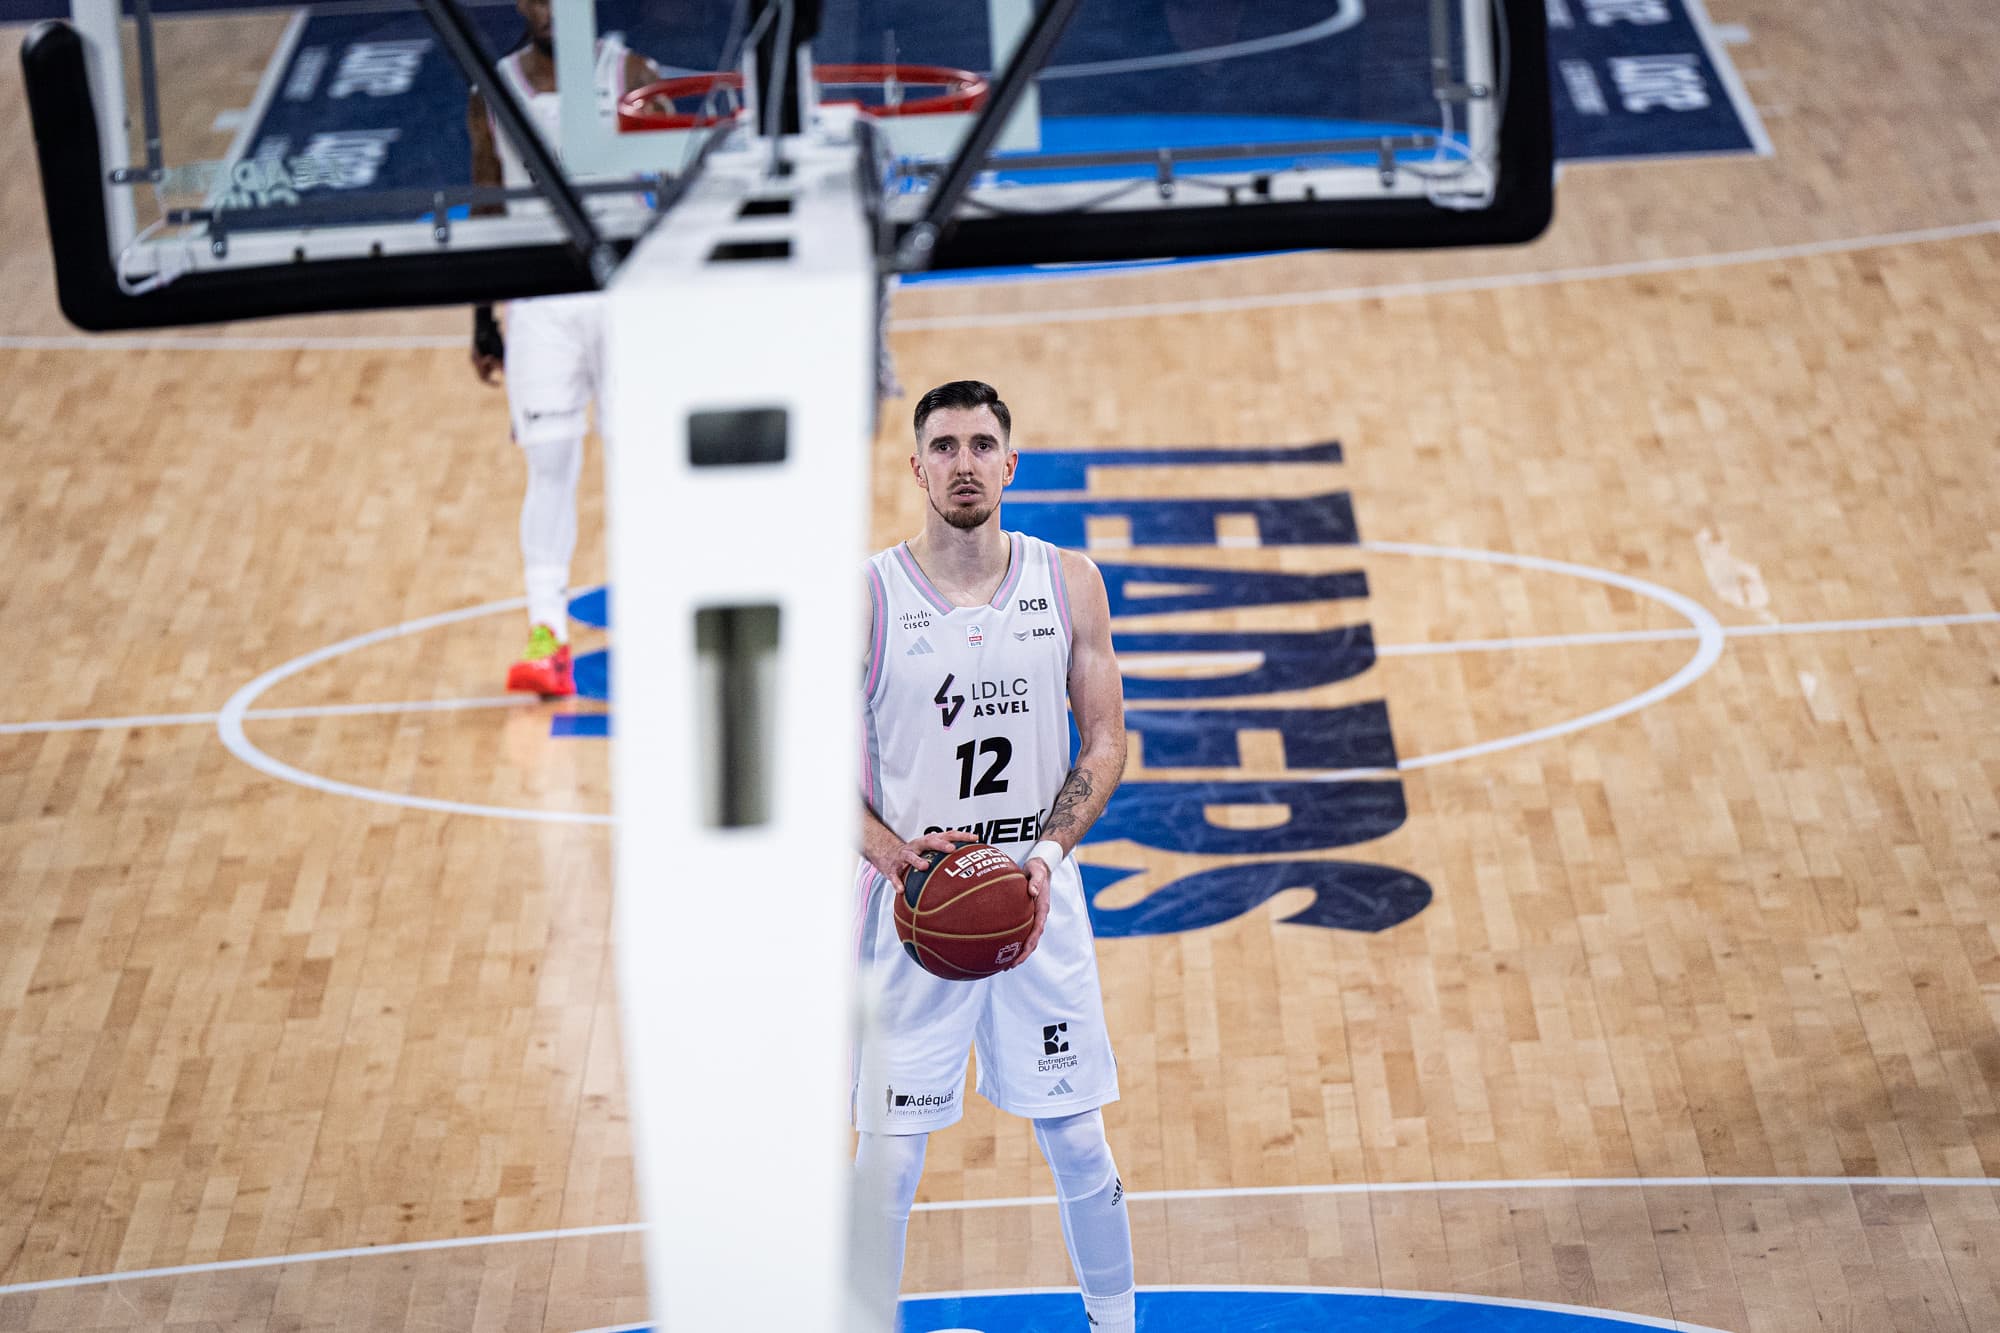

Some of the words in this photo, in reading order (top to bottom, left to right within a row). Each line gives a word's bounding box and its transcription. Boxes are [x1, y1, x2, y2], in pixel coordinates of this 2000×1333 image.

[1018, 598, 1048, 612] DCB
[903, 620, 930, 630] CISCO
[1032, 627, 1056, 637] LDLC
[971, 678, 1028, 701] LDLC
[973, 699, 1030, 718] ASVEL
[955, 736, 1013, 800] 12
[1038, 1054, 1077, 1066] Entreprise
[1051, 1060, 1078, 1071] FUTUR
